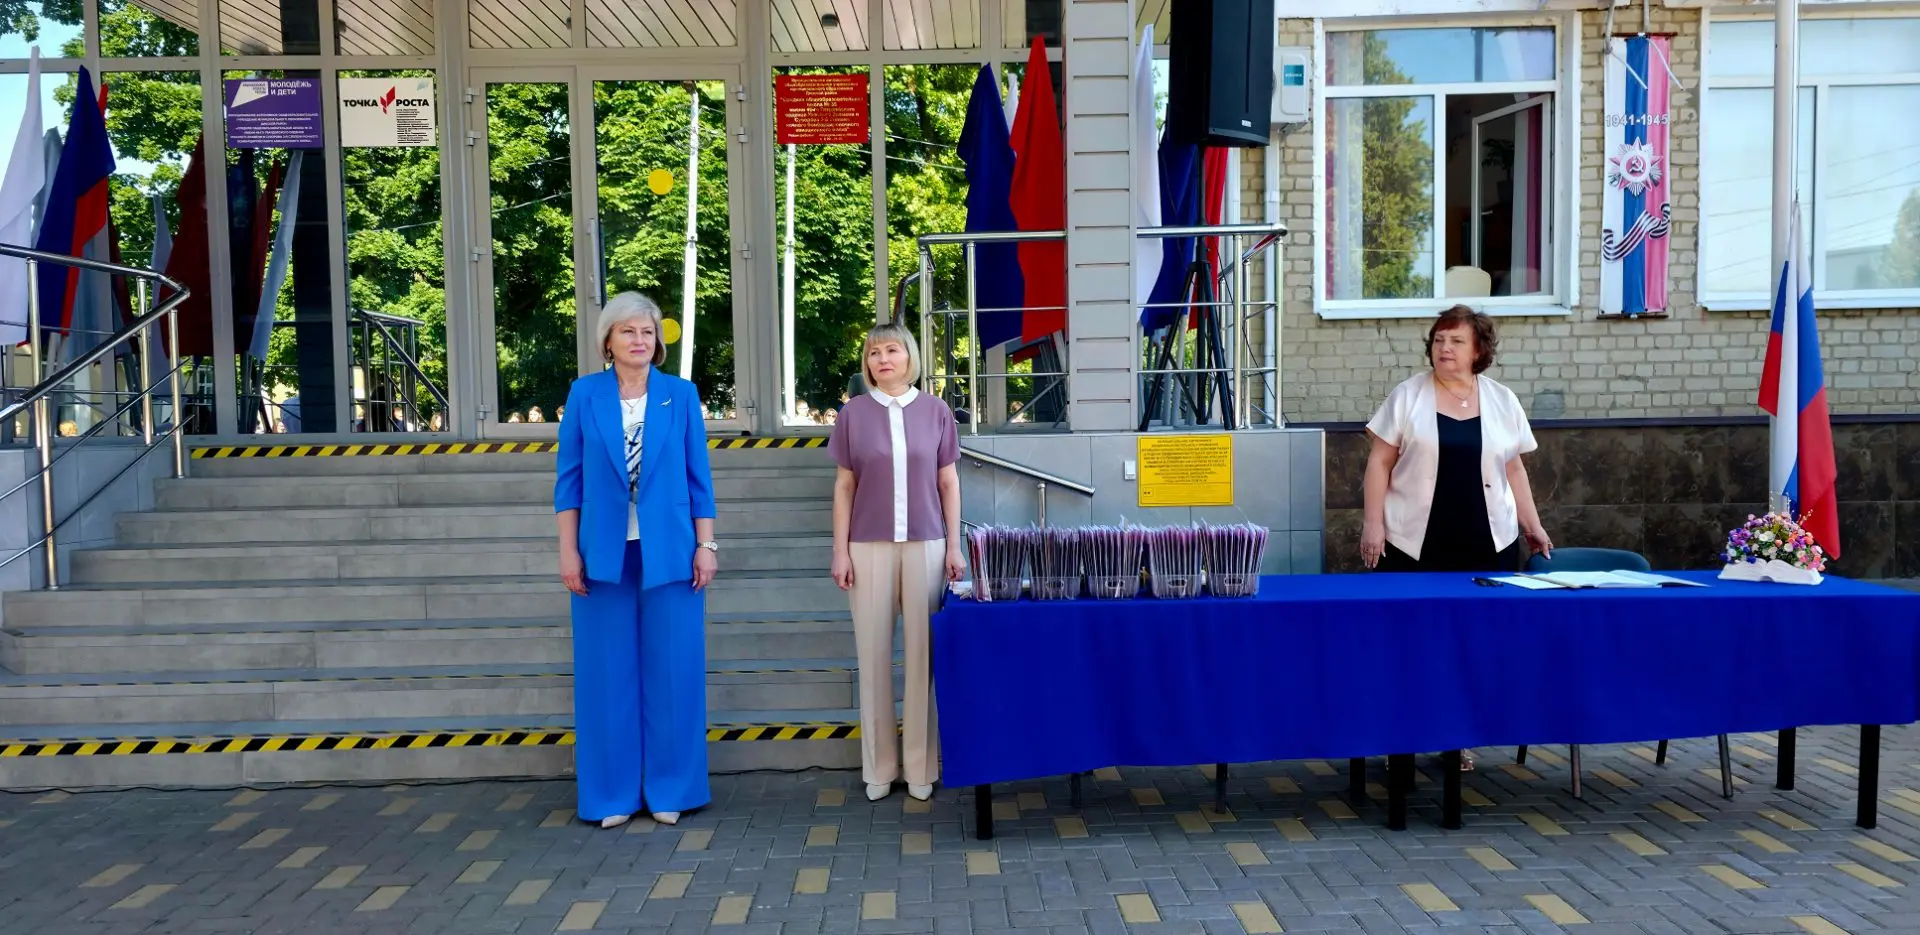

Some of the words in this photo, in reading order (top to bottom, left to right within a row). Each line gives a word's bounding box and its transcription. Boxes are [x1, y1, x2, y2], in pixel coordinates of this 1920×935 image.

[270, 80, 312, 89] МОЛОДЁЖЬ
[270, 88, 277, 96] И
[277, 88, 297, 96] ДЕТИ
[343, 99, 378, 107] ТОЧКА
[396, 98, 430, 107] РОСТА
[1605, 113, 1670, 127] 1941-1945
